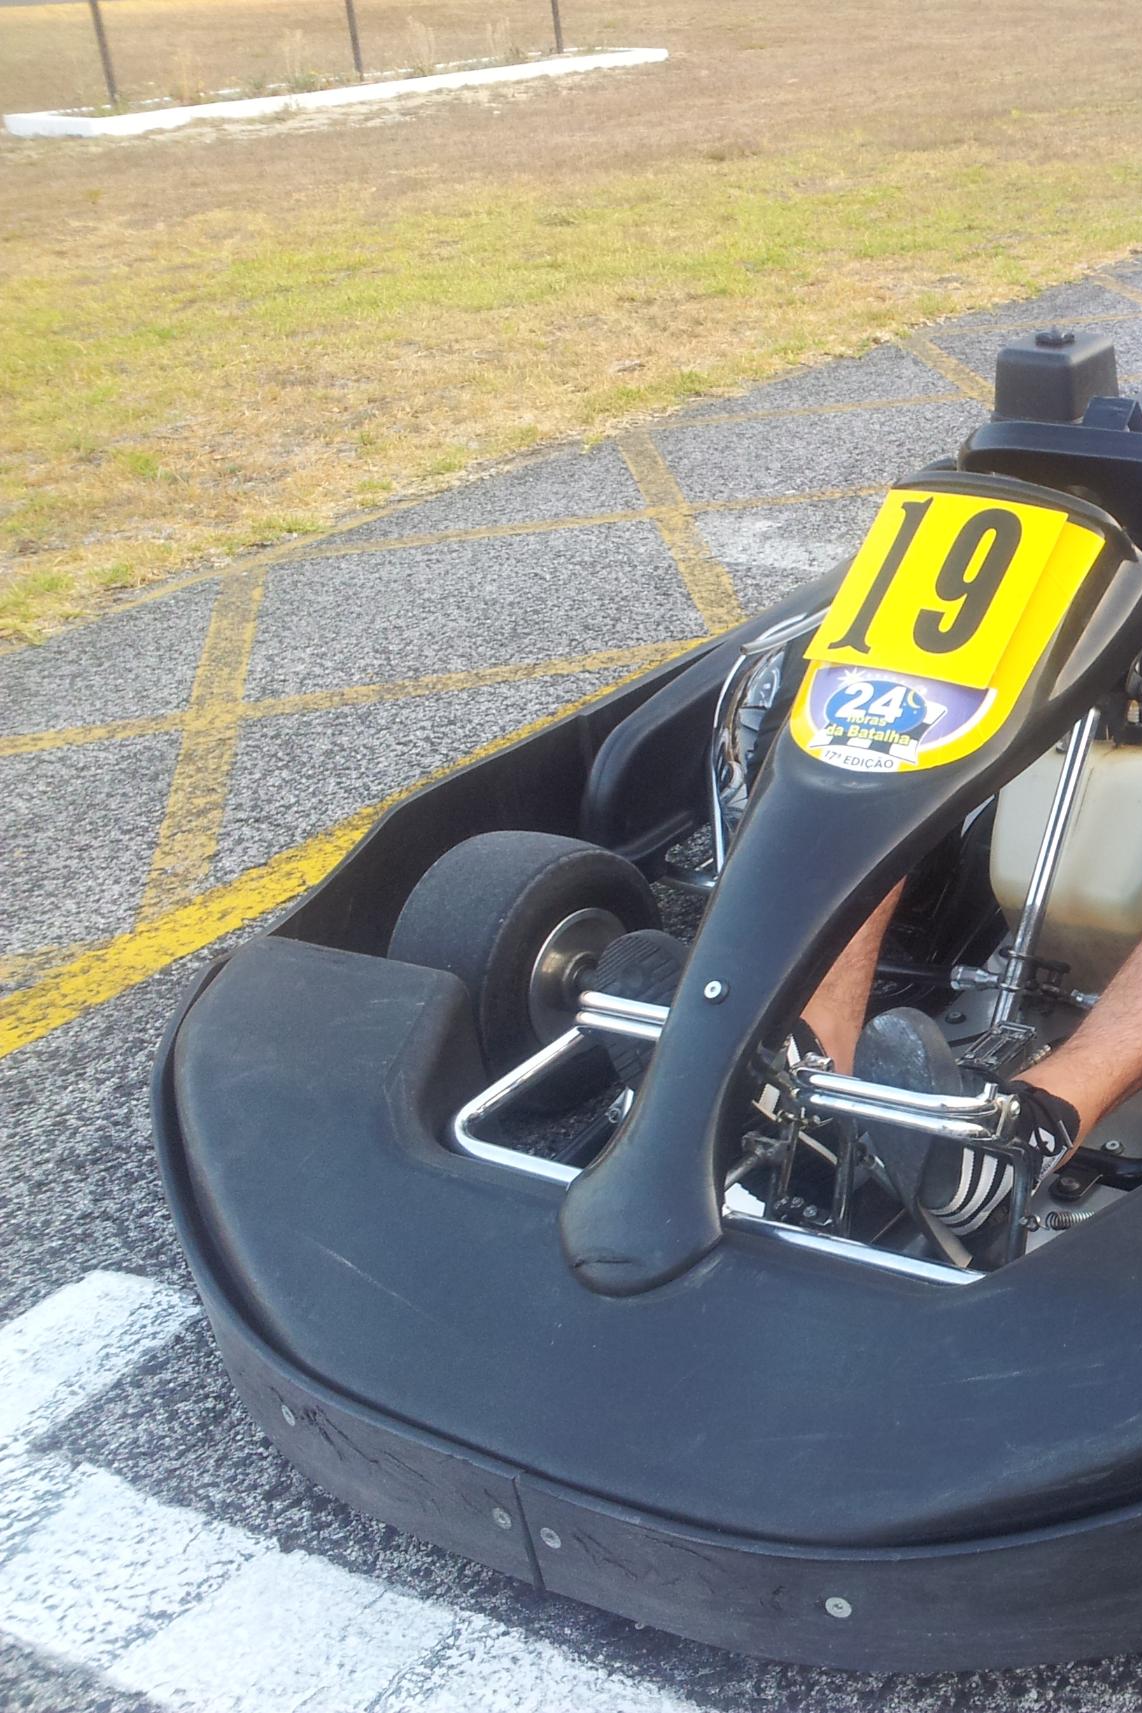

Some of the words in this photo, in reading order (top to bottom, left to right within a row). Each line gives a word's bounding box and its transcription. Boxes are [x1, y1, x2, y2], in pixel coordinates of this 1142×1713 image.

[827, 496, 1023, 654] 19
[835, 682, 907, 723] 24
[847, 713, 888, 727] horas
[826, 723, 845, 737] da
[848, 724, 911, 746] Batalha
[843, 755, 895, 769] EDIÇÃO
